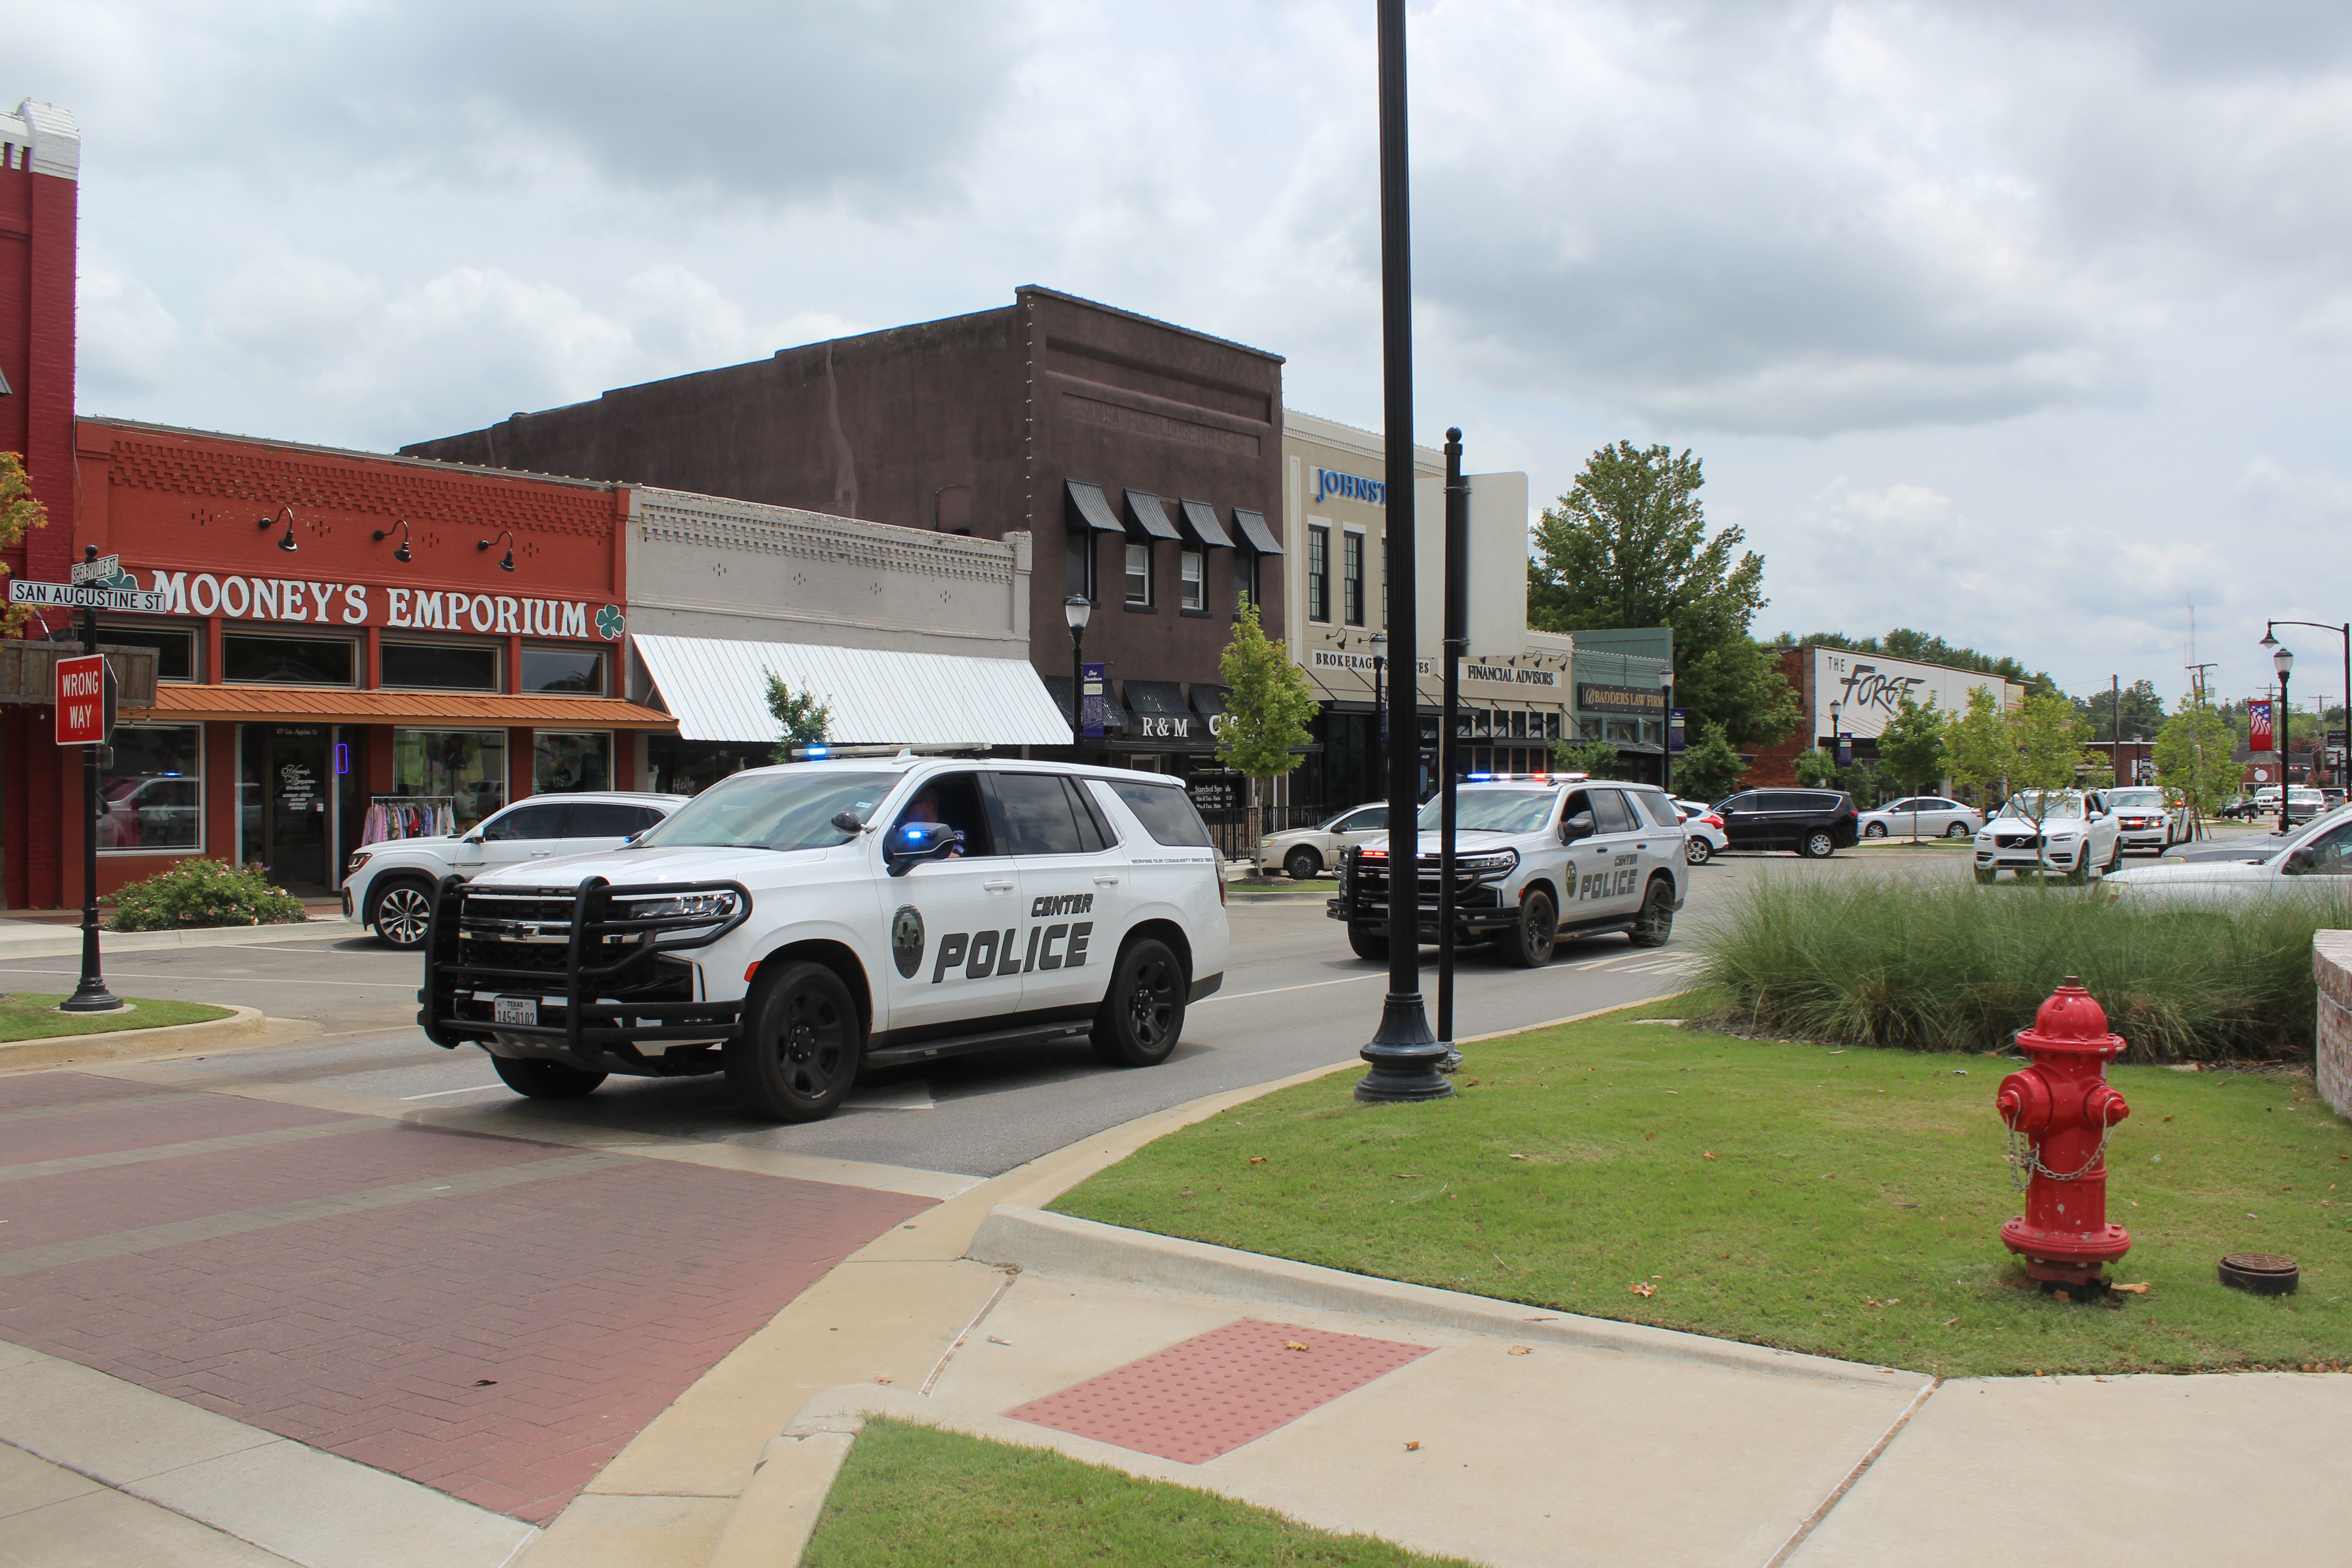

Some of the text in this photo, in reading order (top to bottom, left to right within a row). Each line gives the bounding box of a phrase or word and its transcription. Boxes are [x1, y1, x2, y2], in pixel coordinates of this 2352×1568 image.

[73, 558, 116, 583] SHELBYVILLE ST
[16, 584, 161, 609] SAN AUGUSTINE ST
[152, 570, 588, 638] MOONEY'S EMPORIUM
[1468, 665, 1553, 686] FINANCIAL ADVISORS
[1828, 657, 1845, 672] THE
[63, 671, 98, 697] WRONG
[1840, 664, 1927, 714] FORGE
[1595, 691, 1629, 705] BADDERS
[1631, 693, 1646, 706] LAW
[1647, 695, 1665, 707] FIRM
[70, 705, 92, 729] WAY
[672, 777, 696, 793] Hello
[1214, 785, 1231, 794] Speals
[1614, 854, 1638, 867] CENTER
[1579, 869, 1638, 901] POLICE
[1031, 893, 1093, 917] CENTER
[932, 921, 1093, 984] POLICE
